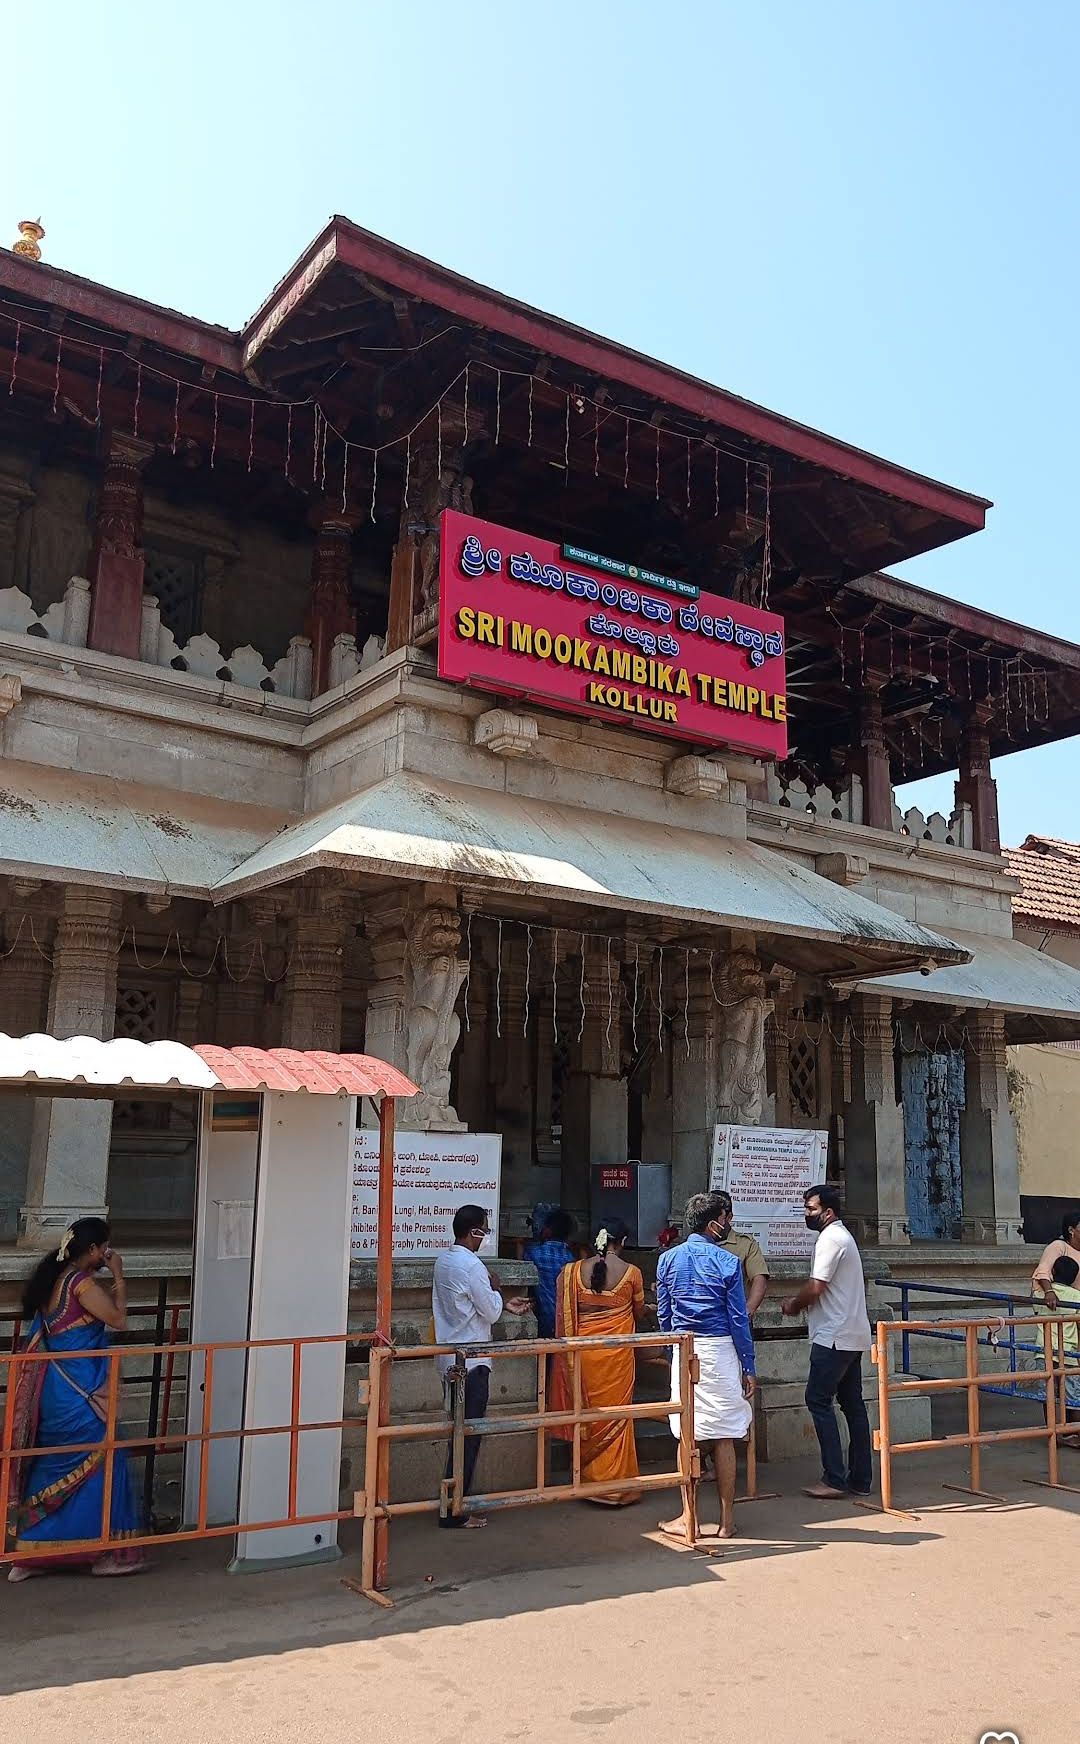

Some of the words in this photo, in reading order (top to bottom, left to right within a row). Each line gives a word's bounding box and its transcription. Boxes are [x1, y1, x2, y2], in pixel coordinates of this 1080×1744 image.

[462, 535, 502, 576] ಶ್ರೀ
[510, 552, 673, 624] ಮೂಕಾಂಬಿಕಾ
[679, 603, 783, 667] ದೇವಸ್ಥಾನ
[589, 613, 680, 657] ಕೊಲ್ಲೂರು
[458, 606, 504, 646] SRI
[511, 620, 691, 697] MOOKAMBIKA
[697, 672, 787, 722] TEMPLE
[590, 681, 678, 722] KOLLUR
[603, 1179, 629, 1188] HUNDI
[362, 1205, 379, 1215] Bani
[394, 1205, 417, 1218] Lungi,
[418, 1205, 432, 1217] Hat,
[351, 1222, 378, 1233] hibited
[402, 1222, 413, 1234] the
[414, 1222, 447, 1233] Premises
[362, 1238, 369, 1249] &
